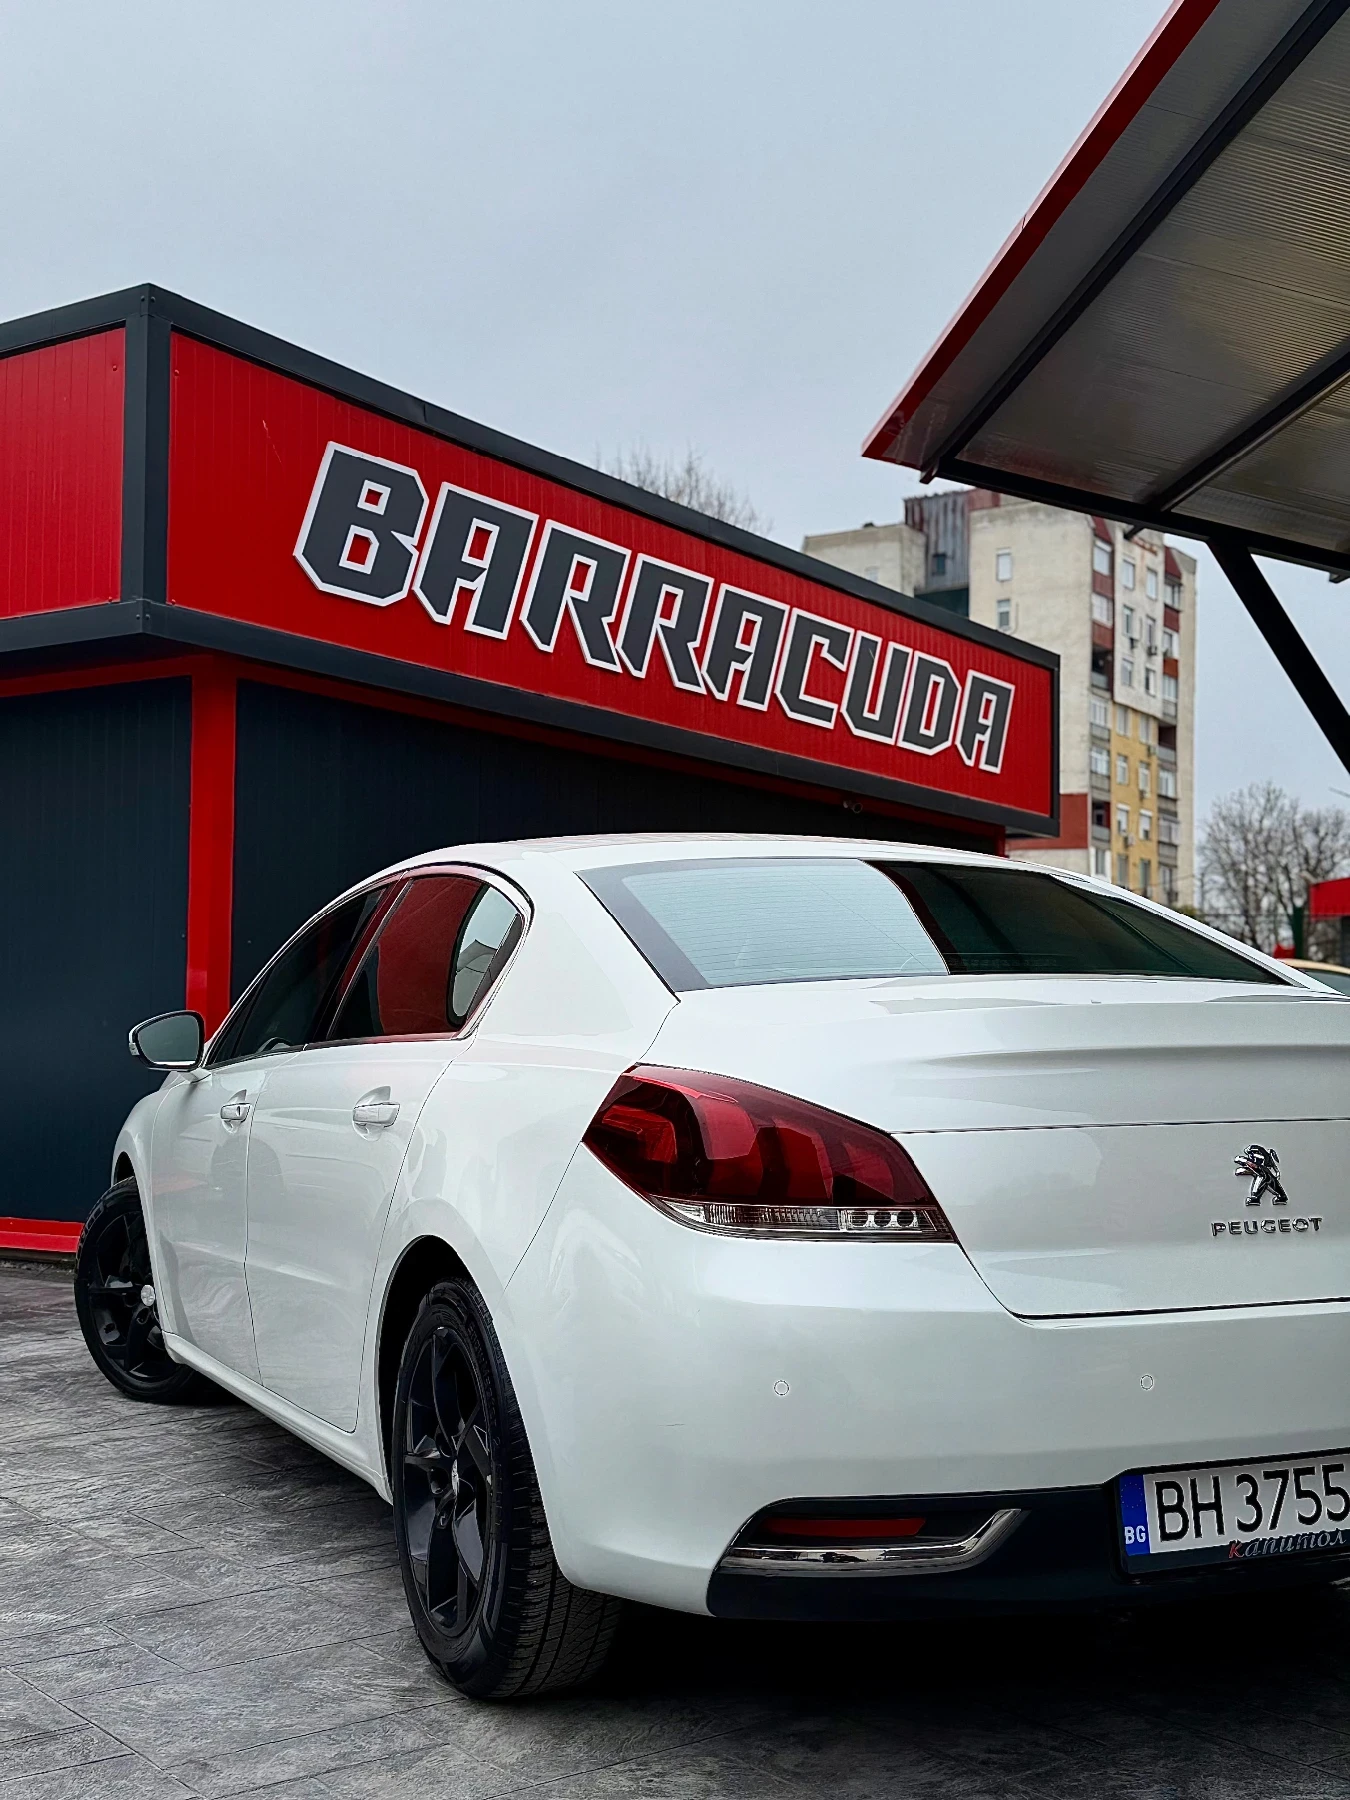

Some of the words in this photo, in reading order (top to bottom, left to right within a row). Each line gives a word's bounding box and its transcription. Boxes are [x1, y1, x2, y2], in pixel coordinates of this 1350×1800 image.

[293, 441, 1015, 774] BARRACUDA
[1211, 1217, 1323, 1237] PEUGEOT
[1155, 1474, 1226, 1542] BH
[1235, 1463, 1350, 1533] 3755
[1124, 1525, 1147, 1545] BG
